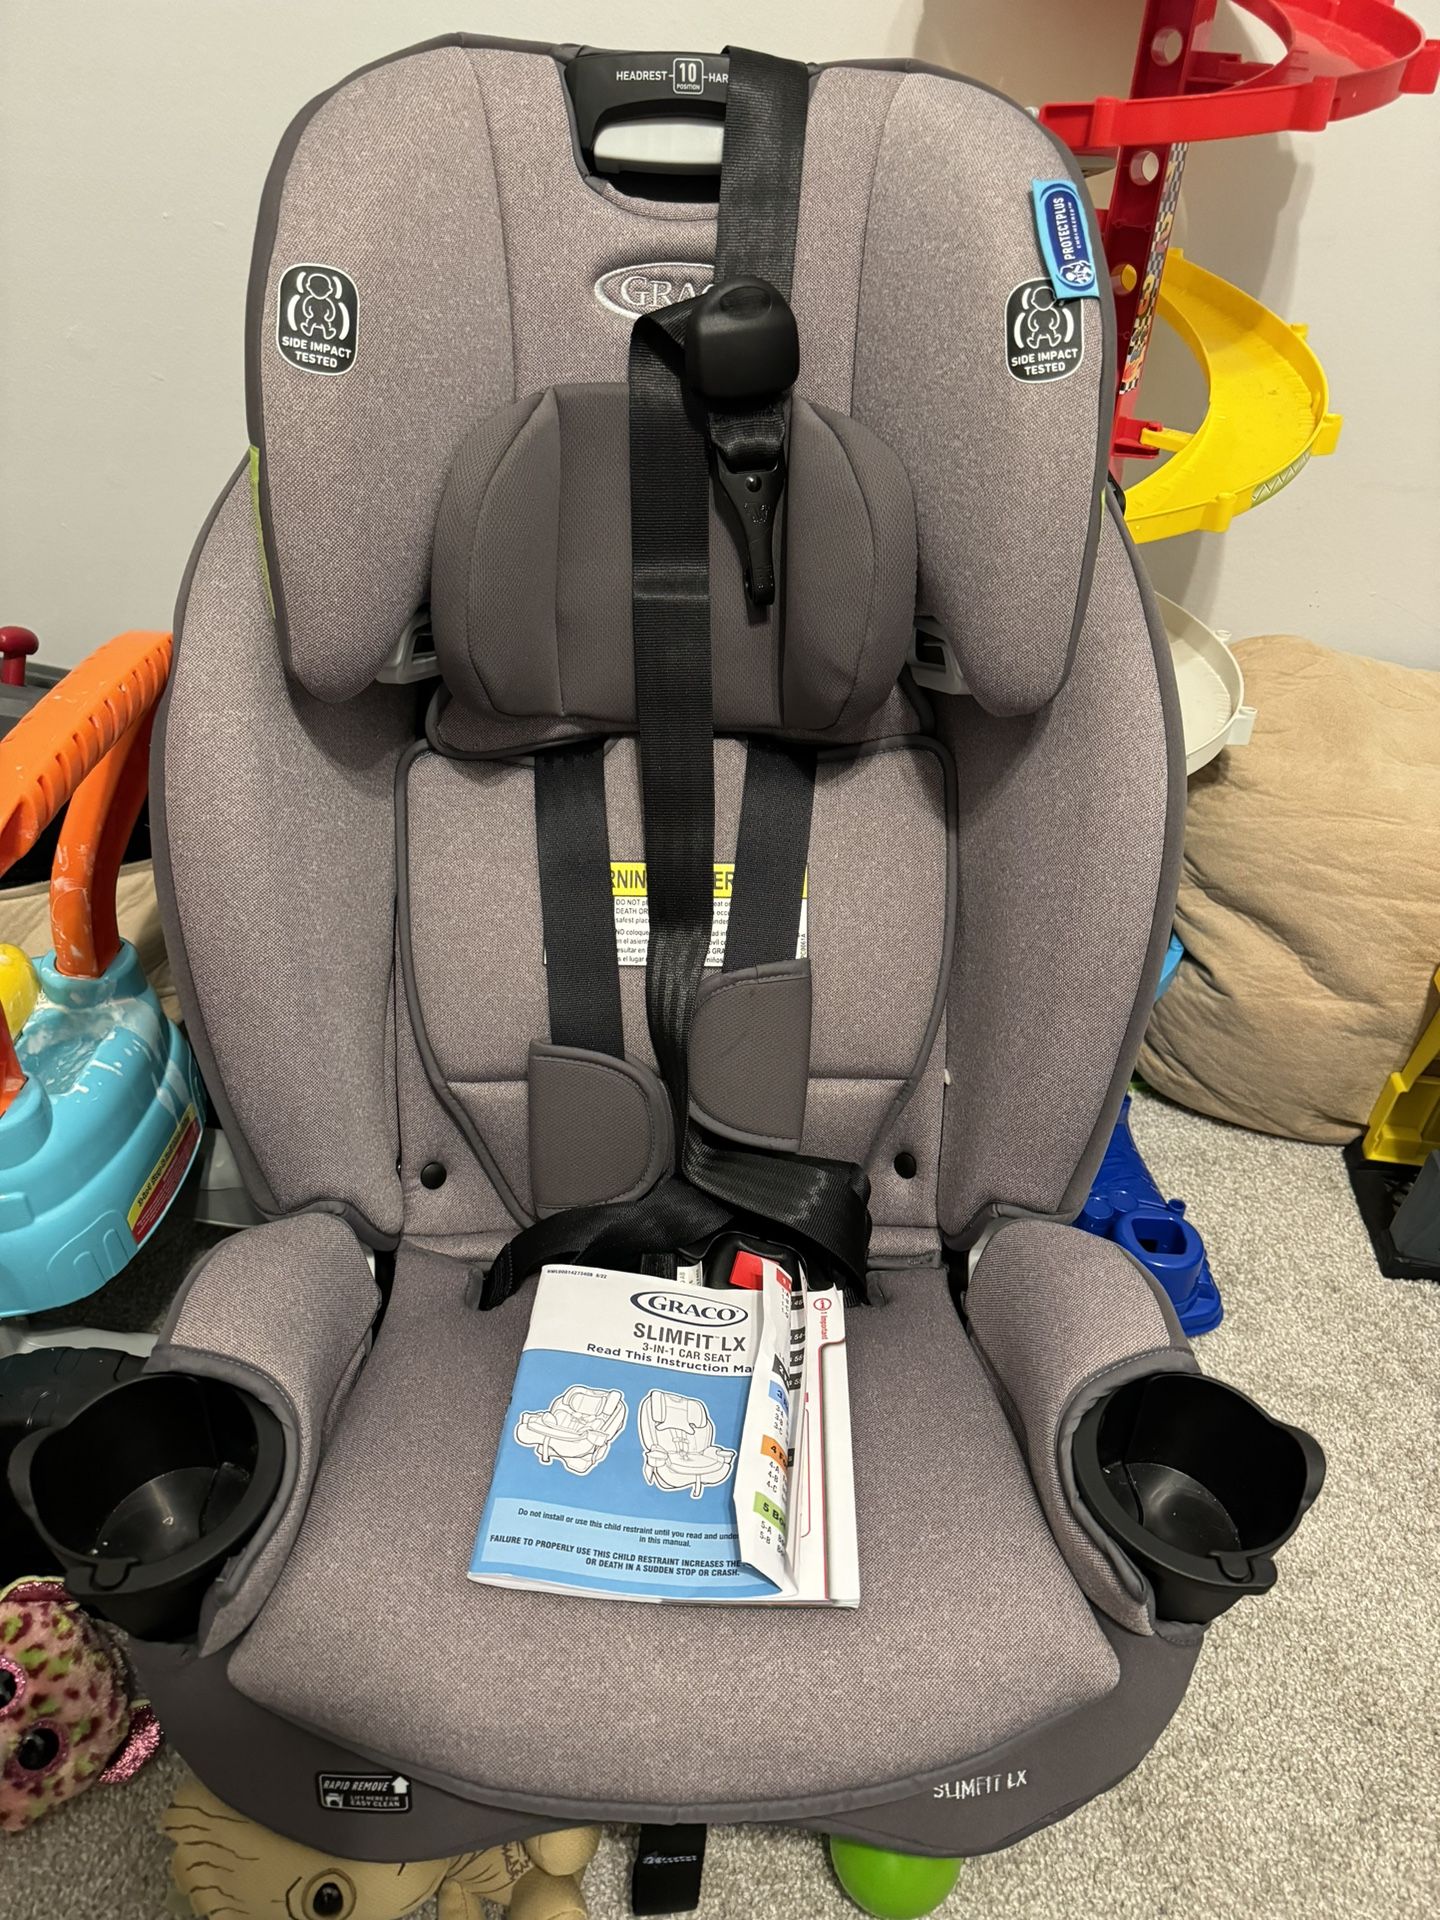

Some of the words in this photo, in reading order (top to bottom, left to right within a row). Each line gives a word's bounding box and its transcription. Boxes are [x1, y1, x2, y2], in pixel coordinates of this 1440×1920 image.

[616, 70, 668, 81] HEADREST
[679, 63, 697, 83] 10
[676, 83, 700, 91] POSITION
[1053, 197, 1076, 260] PROTECTPLUS
[620, 275, 714, 308] GRA
[281, 336, 308, 350] SIDE
[310, 341, 352, 359] IMPACT
[295, 350, 338, 368] TESTED
[1011, 353, 1036, 367] SIDE
[1038, 348, 1078, 362] IMPACT
[1024, 361, 1066, 376] TESTED
[615, 898, 625, 906] DO
[627, 898, 640, 906] NOT
[615, 907, 637, 915] DEATH
[628, 955, 644, 963] lugar
[648, 1295, 738, 1321] GRACO
[633, 1322, 714, 1350] SLIMFIT
[721, 1336, 746, 1352] LX
[586, 1343, 621, 1357] Read
[624, 1349, 652, 1363] This
[656, 1355, 729, 1373] Instruction
[642, 1342, 674, 1356] 3-IN-1
[678, 1348, 700, 1360] CAR
[704, 1352, 732, 1363] SEAT
[763, 1502, 770, 1512] 5
[518, 1507, 528, 1516] Do
[529, 1510, 542, 1518] not
[542, 1511, 565, 1522] install
[575, 1518, 588, 1526] use
[589, 1519, 603, 1529] this
[603, 1522, 621, 1531] child
[622, 1525, 653, 1535] restraint
[654, 1528, 670, 1536] until
[686, 1530, 702, 1539] read
[704, 1532, 718, 1540] and
[760, 1520, 772, 1535] 5-A
[639, 1535, 646, 1543] in
[647, 1536, 661, 1545] this
[662, 1538, 691, 1547] manual.
[760, 1530, 771, 1544] 5-B
[489, 1534, 521, 1545] FAILURE
[523, 1537, 534, 1546] TO
[535, 1539, 575, 1553] PROPERLY
[576, 1546, 591, 1556] USE
[593, 1549, 611, 1559] THIS
[612, 1552, 636, 1561] CHILD
[637, 1553, 680, 1566] RESTRAINT
[681, 1559, 724, 1568] INCREASES
[726, 1560, 741, 1568] THE
[585, 1557, 597, 1566] OR
[598, 1558, 624, 1570] DEATH
[625, 1563, 634, 1571] IN
[642, 1564, 674, 1574] SUDDEN
[675, 1567, 697, 1576] STOP
[698, 1568, 710, 1576] OR
[711, 1568, 740, 1577] CRASH.
[323, 1780, 351, 1791] RAPID
[351, 1781, 390, 1792] REMOVE
[933, 1774, 1002, 1799] SLIMFIT
[1007, 1769, 1028, 1789] LX
